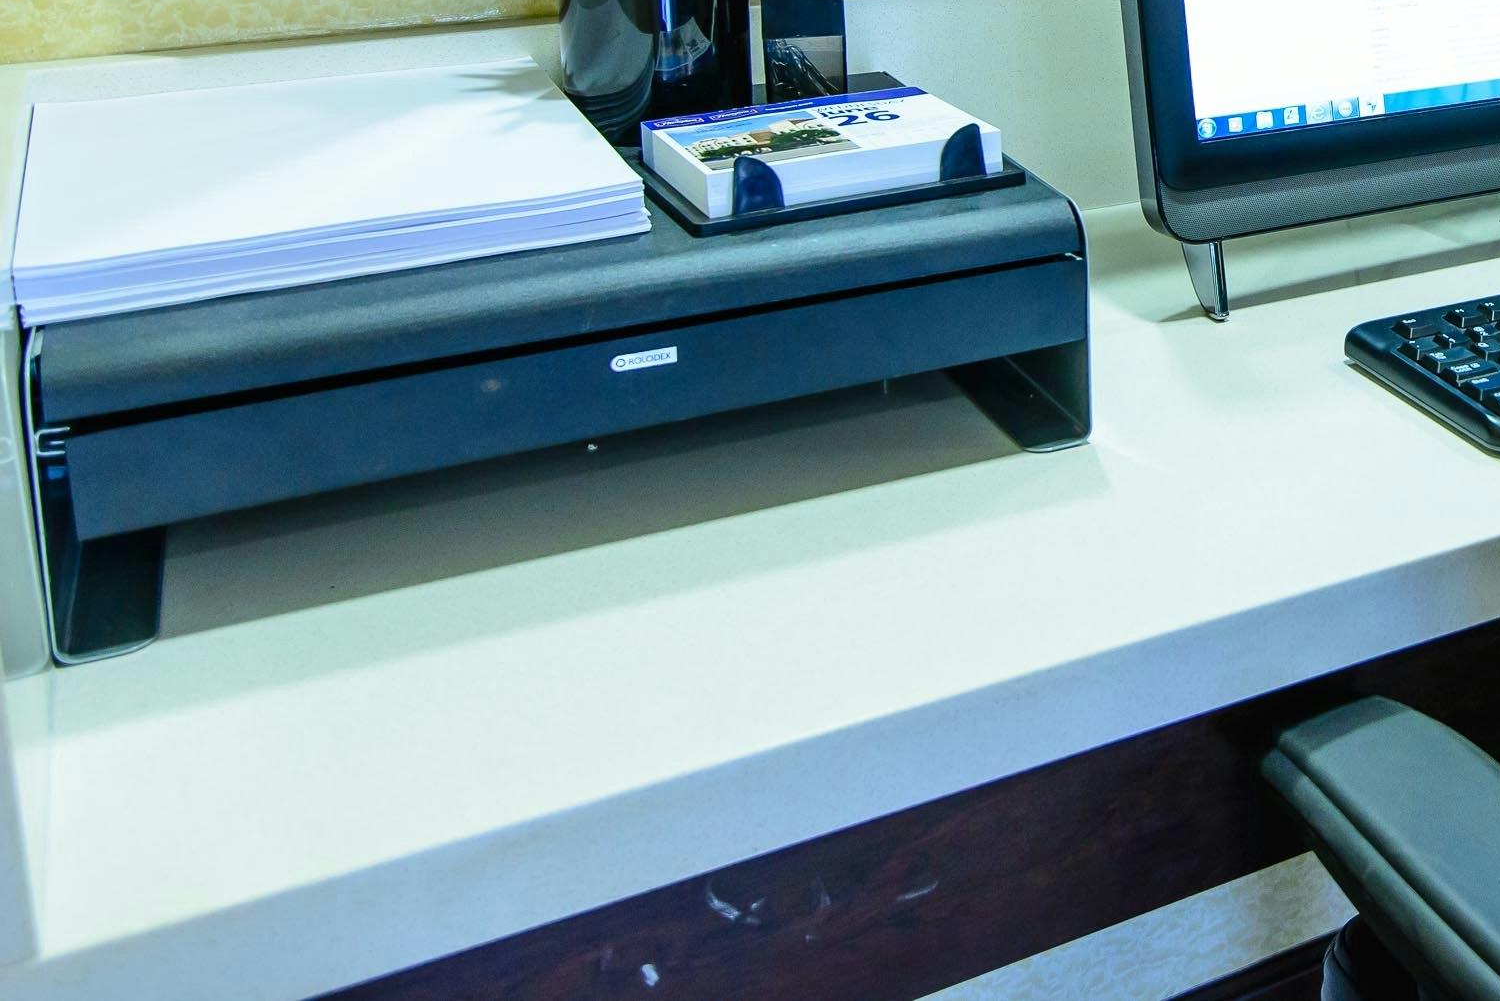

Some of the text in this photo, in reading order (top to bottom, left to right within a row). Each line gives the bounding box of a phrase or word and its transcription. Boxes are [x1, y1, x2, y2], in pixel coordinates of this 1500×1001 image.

[817, 106, 880, 118] June
[828, 110, 901, 127] 26
[628, 351, 672, 366] ROLODEX
